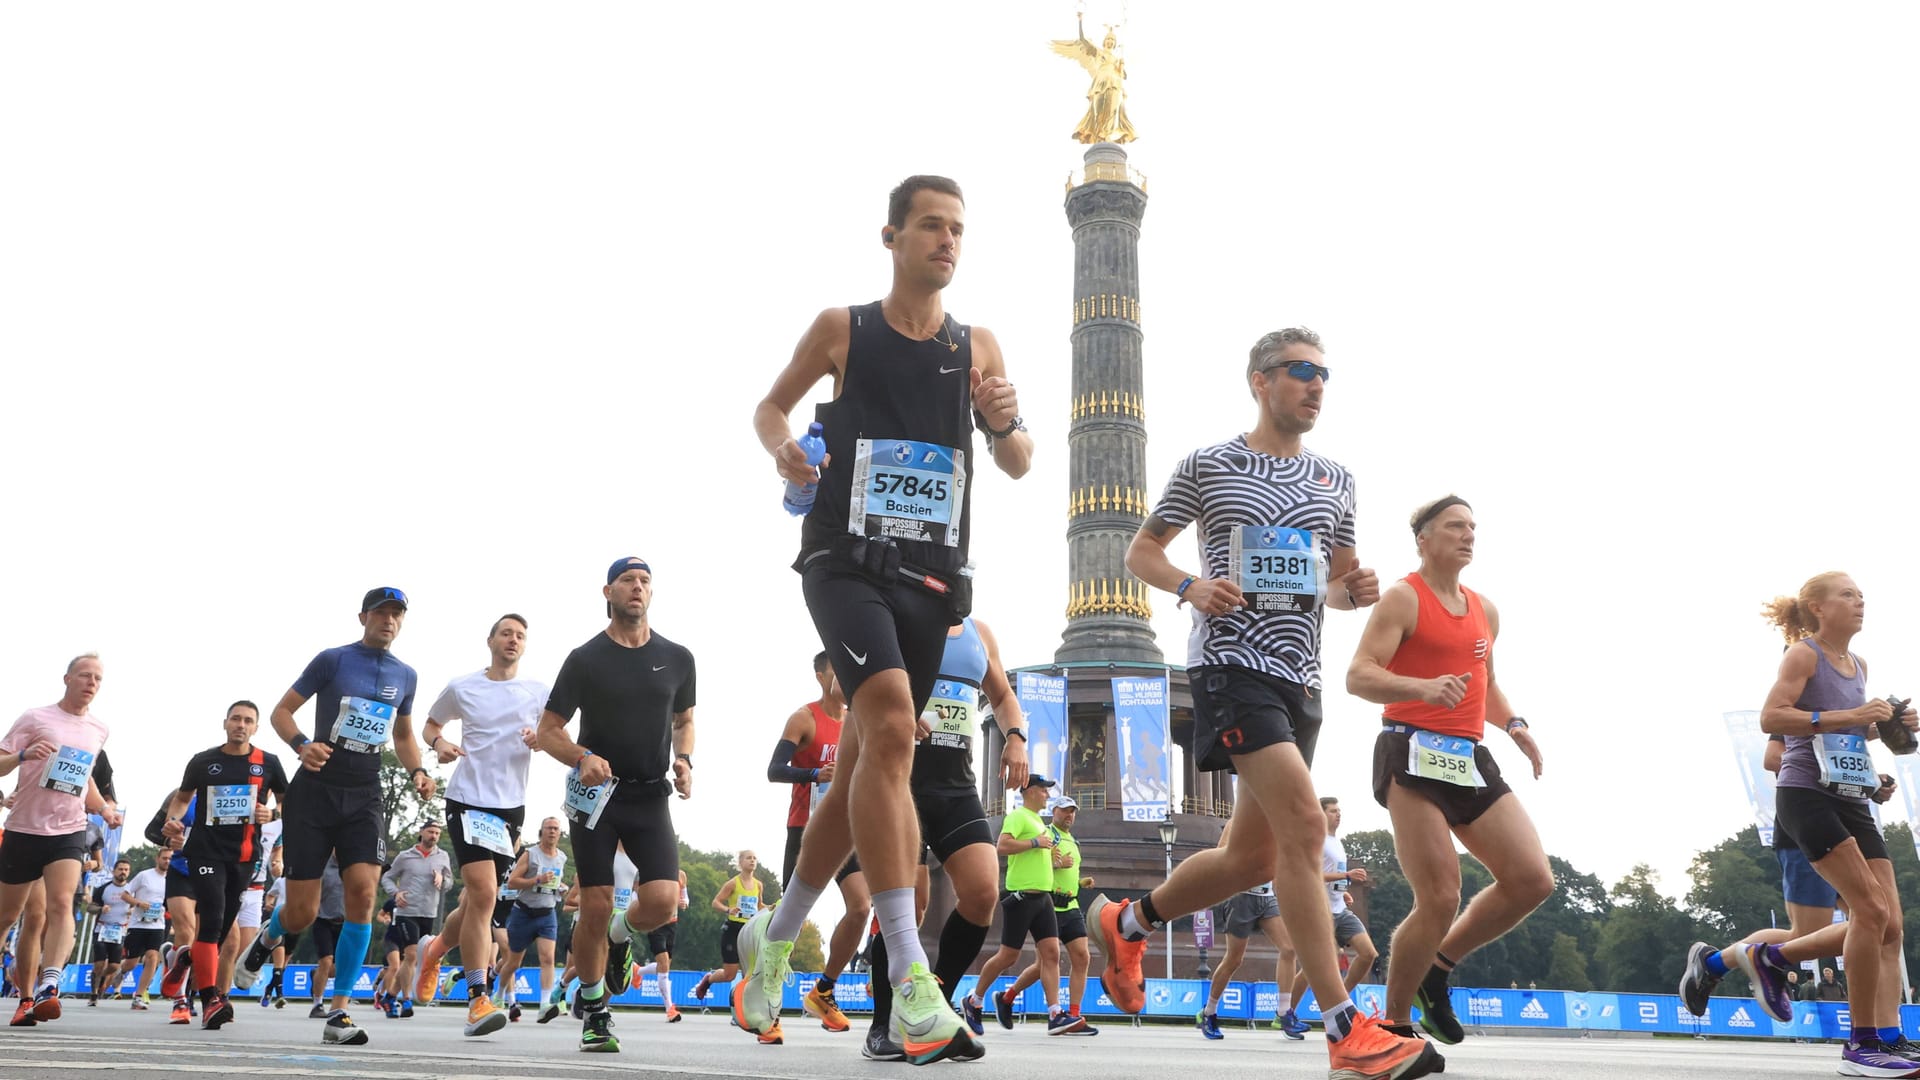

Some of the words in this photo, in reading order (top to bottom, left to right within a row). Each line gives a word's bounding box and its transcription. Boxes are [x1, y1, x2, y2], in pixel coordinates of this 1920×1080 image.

[873, 472, 947, 501] 57845
[886, 499, 932, 516] Bastien
[881, 517, 925, 531] IMPOSSIBLE
[1250, 556, 1308, 576] 31381
[1256, 578, 1304, 590] Christian
[1256, 593, 1295, 603] IMPOSSIBLE
[346, 714, 386, 735] 33243
[58, 761, 88, 776] 17994
[1427, 752, 1467, 774] 3358
[1830, 755, 1870, 773] 16354
[1442, 771, 1457, 782] Jan
[215, 798, 248, 809] 32510
[1256, 993, 1277, 1001] BMW
[1727, 1019, 1756, 1028] adidas
